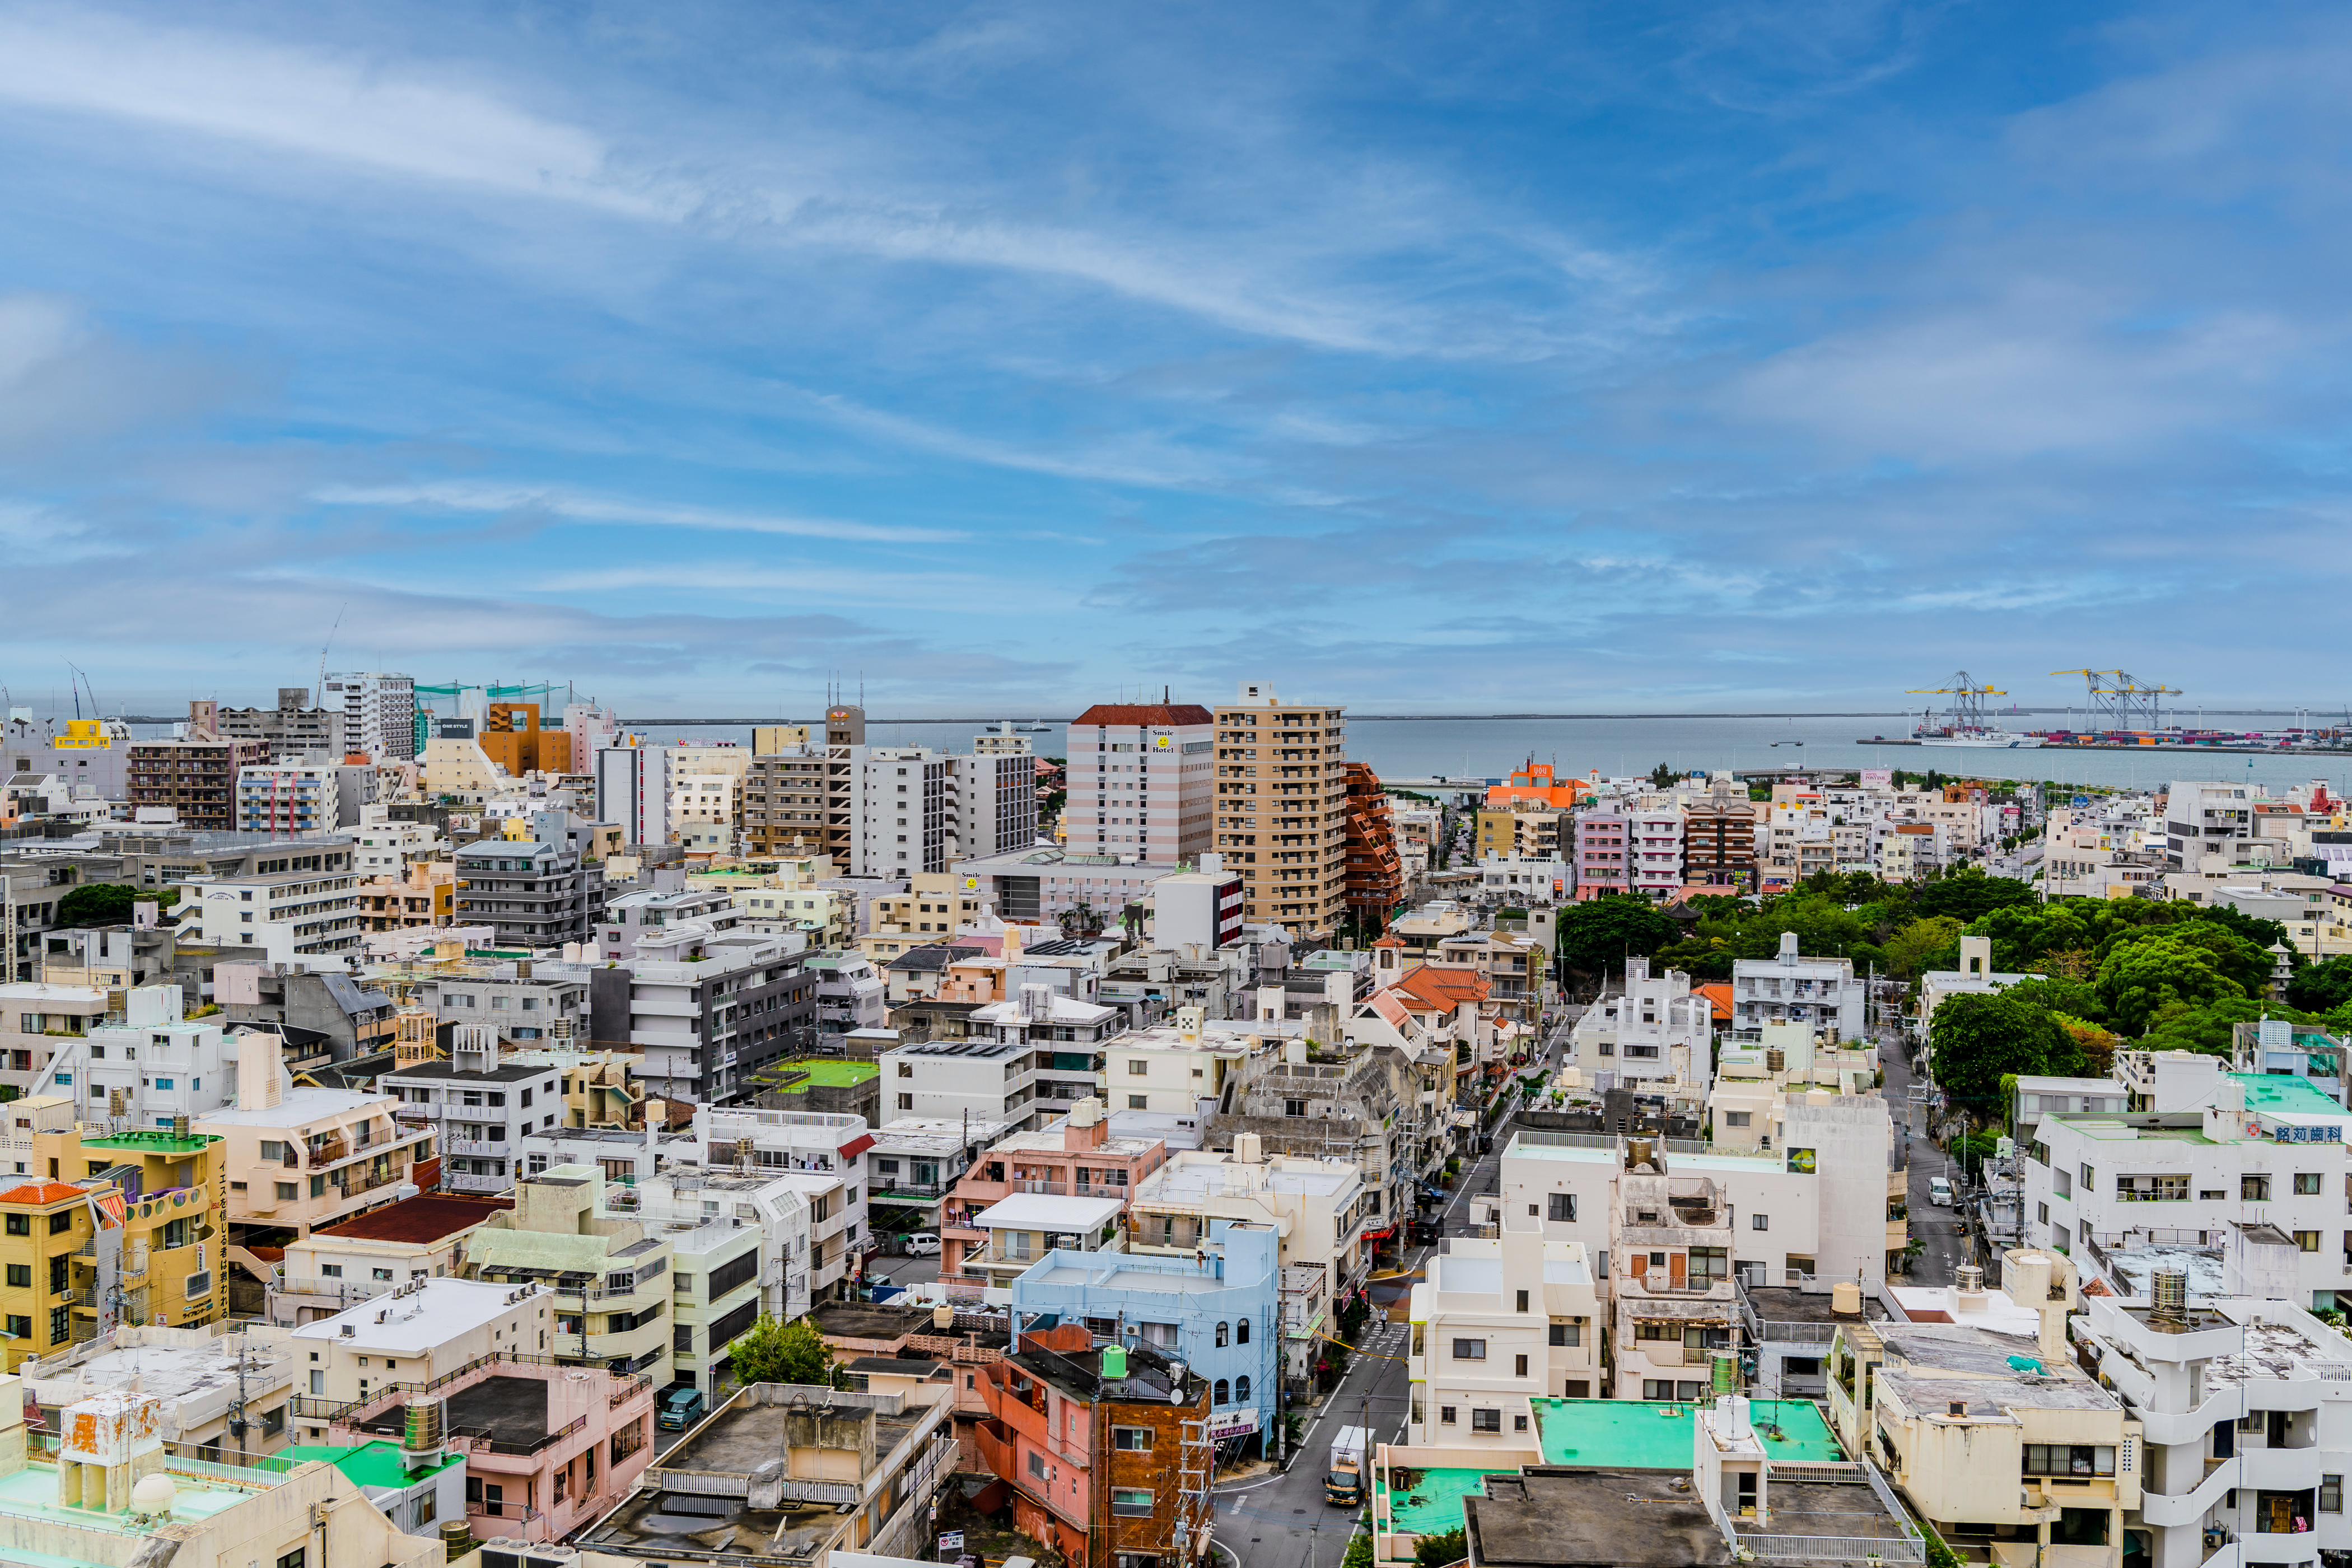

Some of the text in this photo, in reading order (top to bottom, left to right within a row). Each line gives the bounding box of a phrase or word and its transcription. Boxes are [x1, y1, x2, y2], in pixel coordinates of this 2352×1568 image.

[2276, 1127, 2341, 1142] 銘苅歯科
[211, 1201, 220, 1210] Jesus
[219, 1160, 228, 1319] イエスを信じる者は救われる
[183, 1308, 207, 1319] ライフセンター
